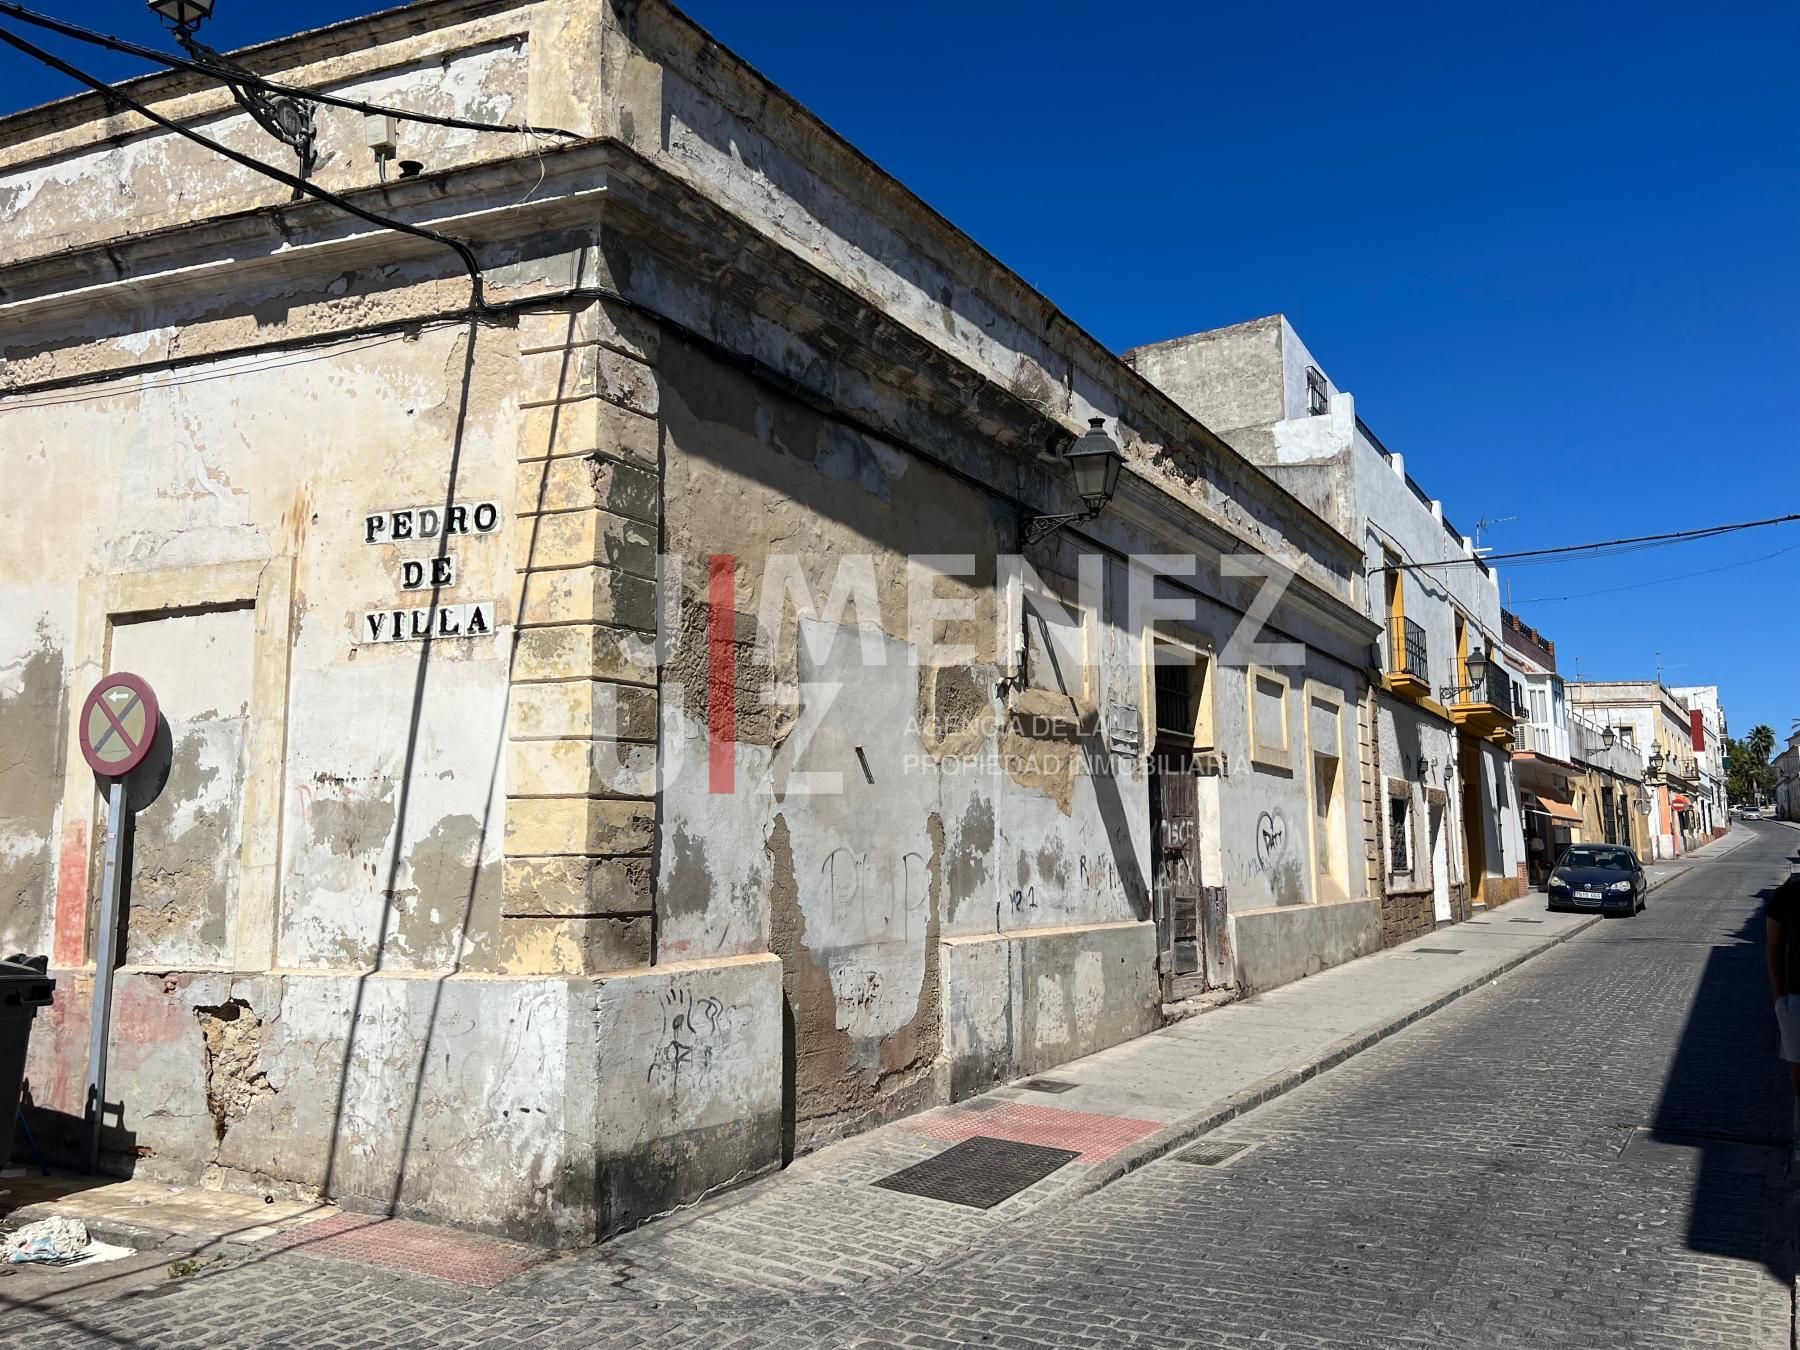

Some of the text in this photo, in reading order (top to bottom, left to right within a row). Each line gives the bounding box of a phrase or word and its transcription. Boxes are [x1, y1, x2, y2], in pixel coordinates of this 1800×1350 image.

[364, 502, 499, 544] PEDRO
[402, 556, 453, 590] DE
[366, 605, 490, 642] VILLA
